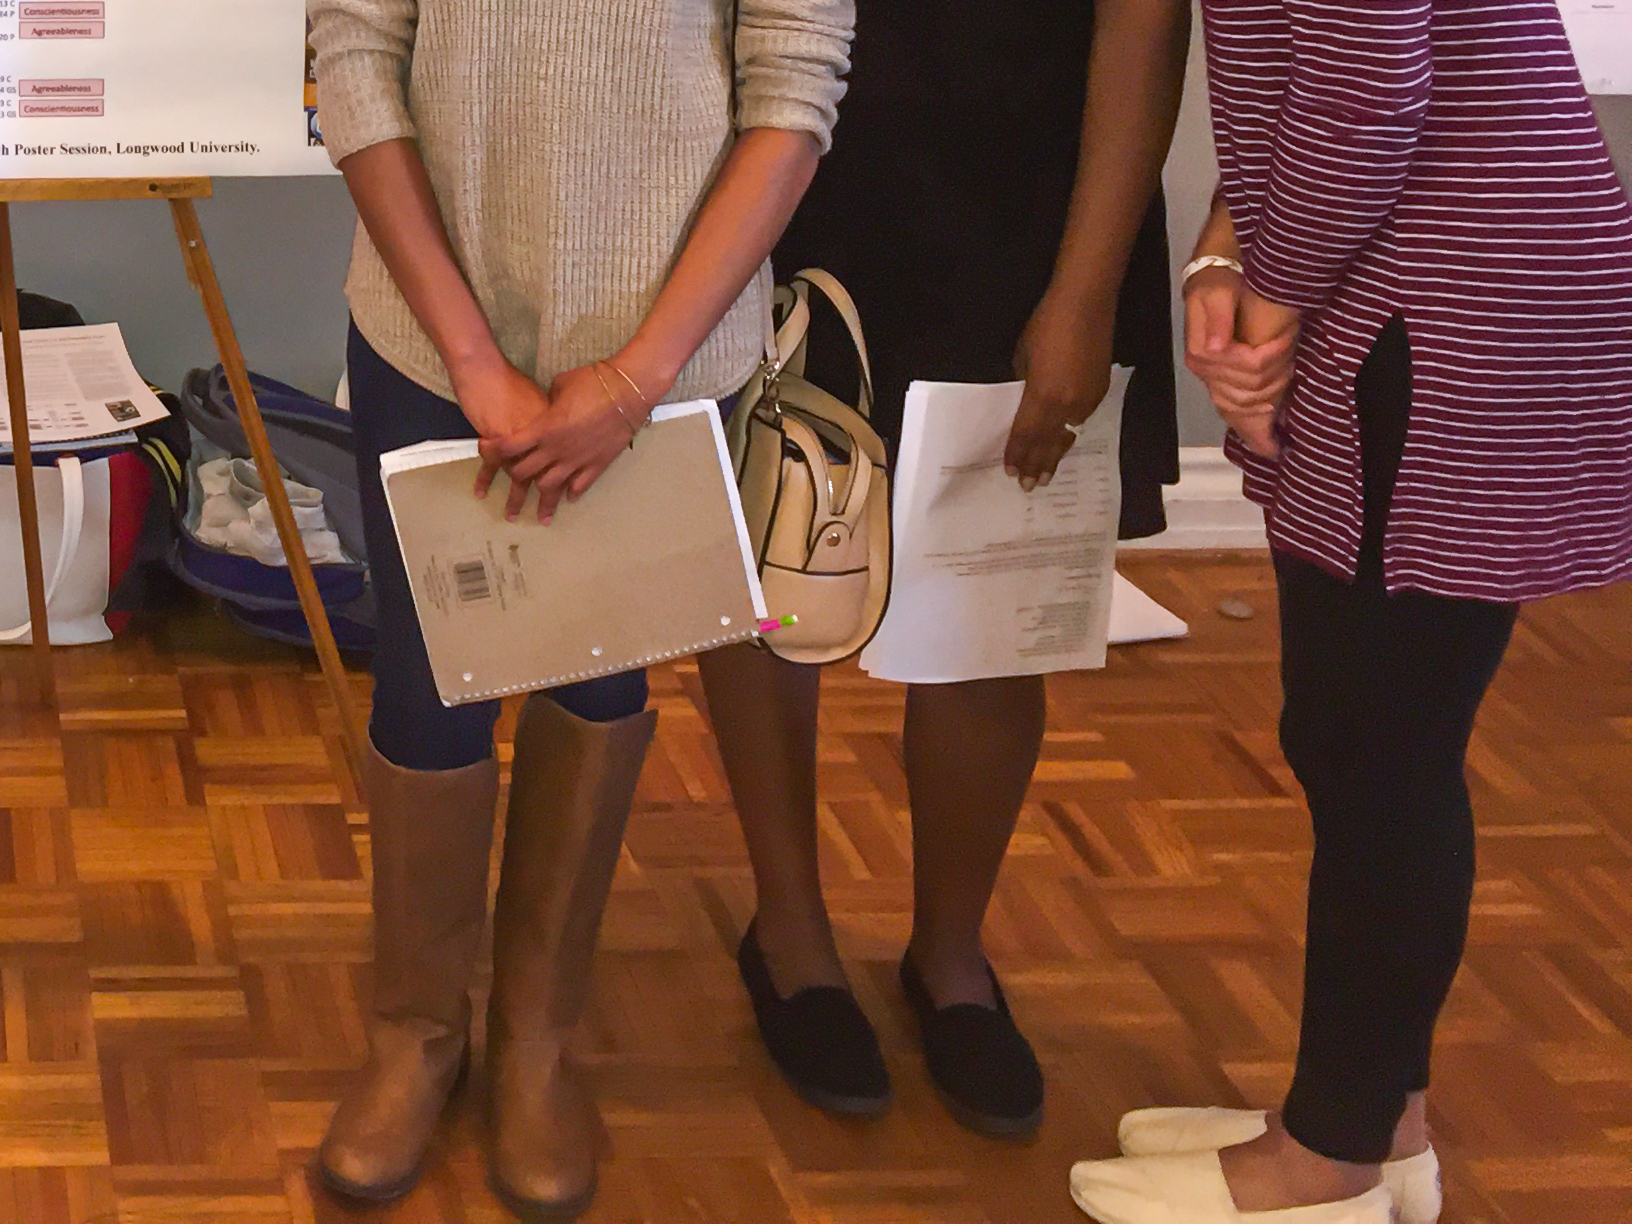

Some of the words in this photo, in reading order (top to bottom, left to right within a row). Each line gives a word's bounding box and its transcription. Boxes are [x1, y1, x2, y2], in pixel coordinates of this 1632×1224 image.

[14, 143, 56, 156] Poster
[59, 142, 111, 156] Session,
[116, 141, 184, 157] Longwood
[189, 140, 260, 156] University.
